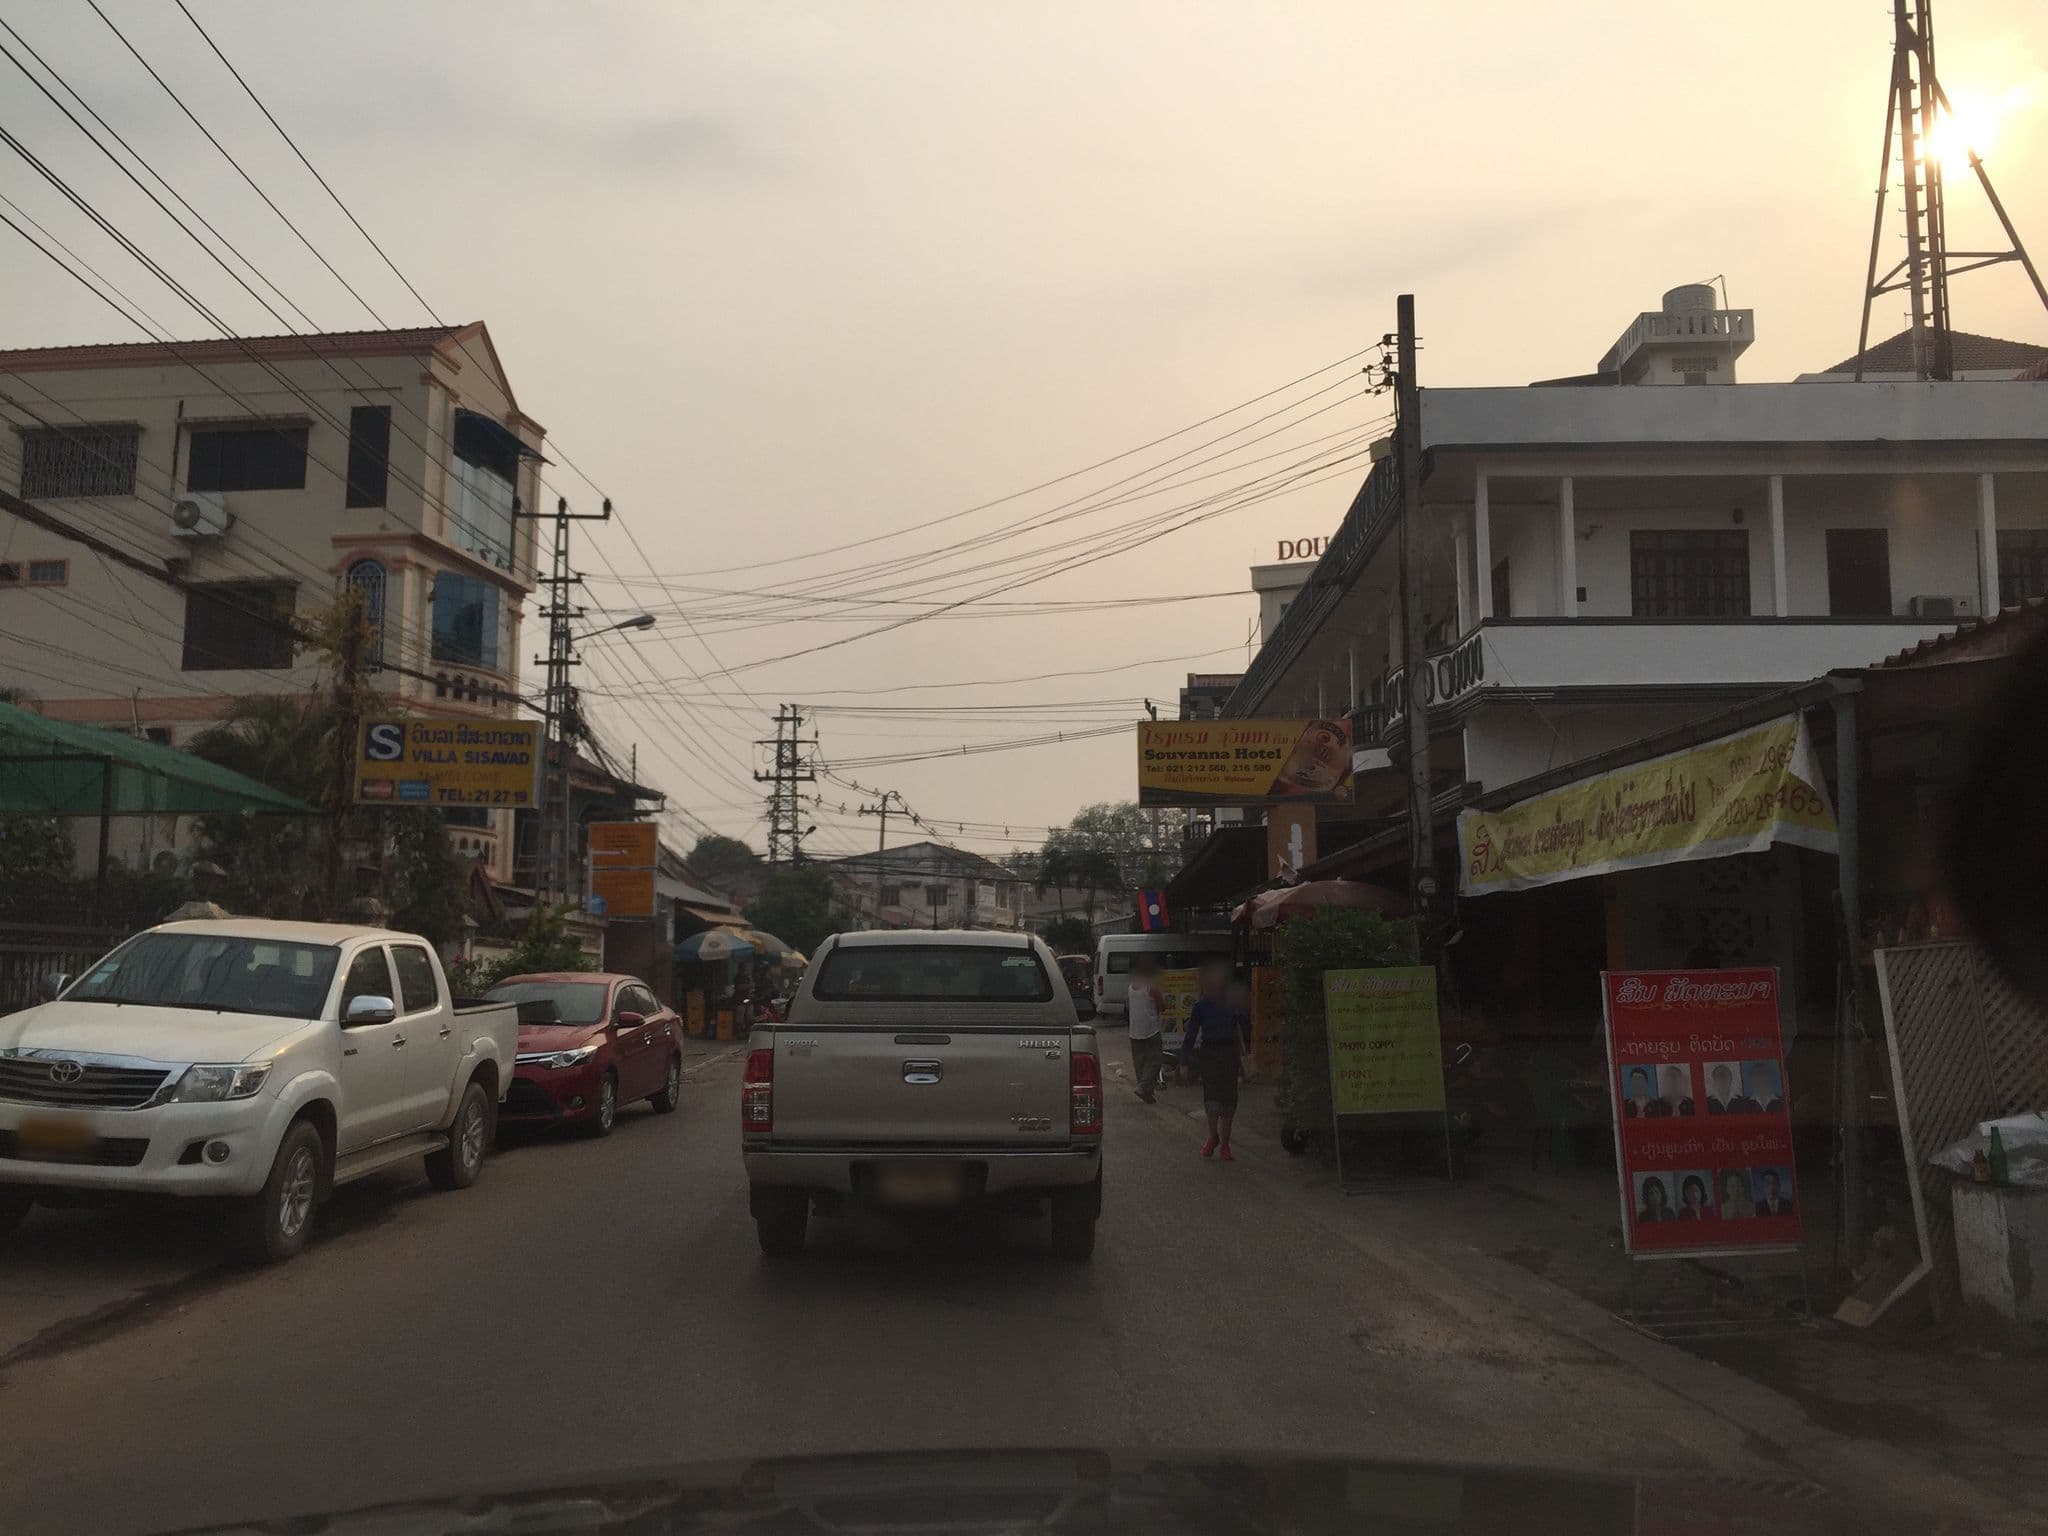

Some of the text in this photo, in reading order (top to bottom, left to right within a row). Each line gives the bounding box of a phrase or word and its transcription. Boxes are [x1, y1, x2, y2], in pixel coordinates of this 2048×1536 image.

[368, 723, 402, 760] S
[412, 749, 458, 764] VILLA
[1144, 747, 1282, 761] Souvanna Hotel
[1146, 764, 1163, 773] Tel:
[1166, 764, 1183, 773] 021
[1187, 764, 1206, 773] 212
[783, 1039, 1061, 1049] TOYOTA HILUX
[1339, 1040, 1366, 1050] PHOTO
